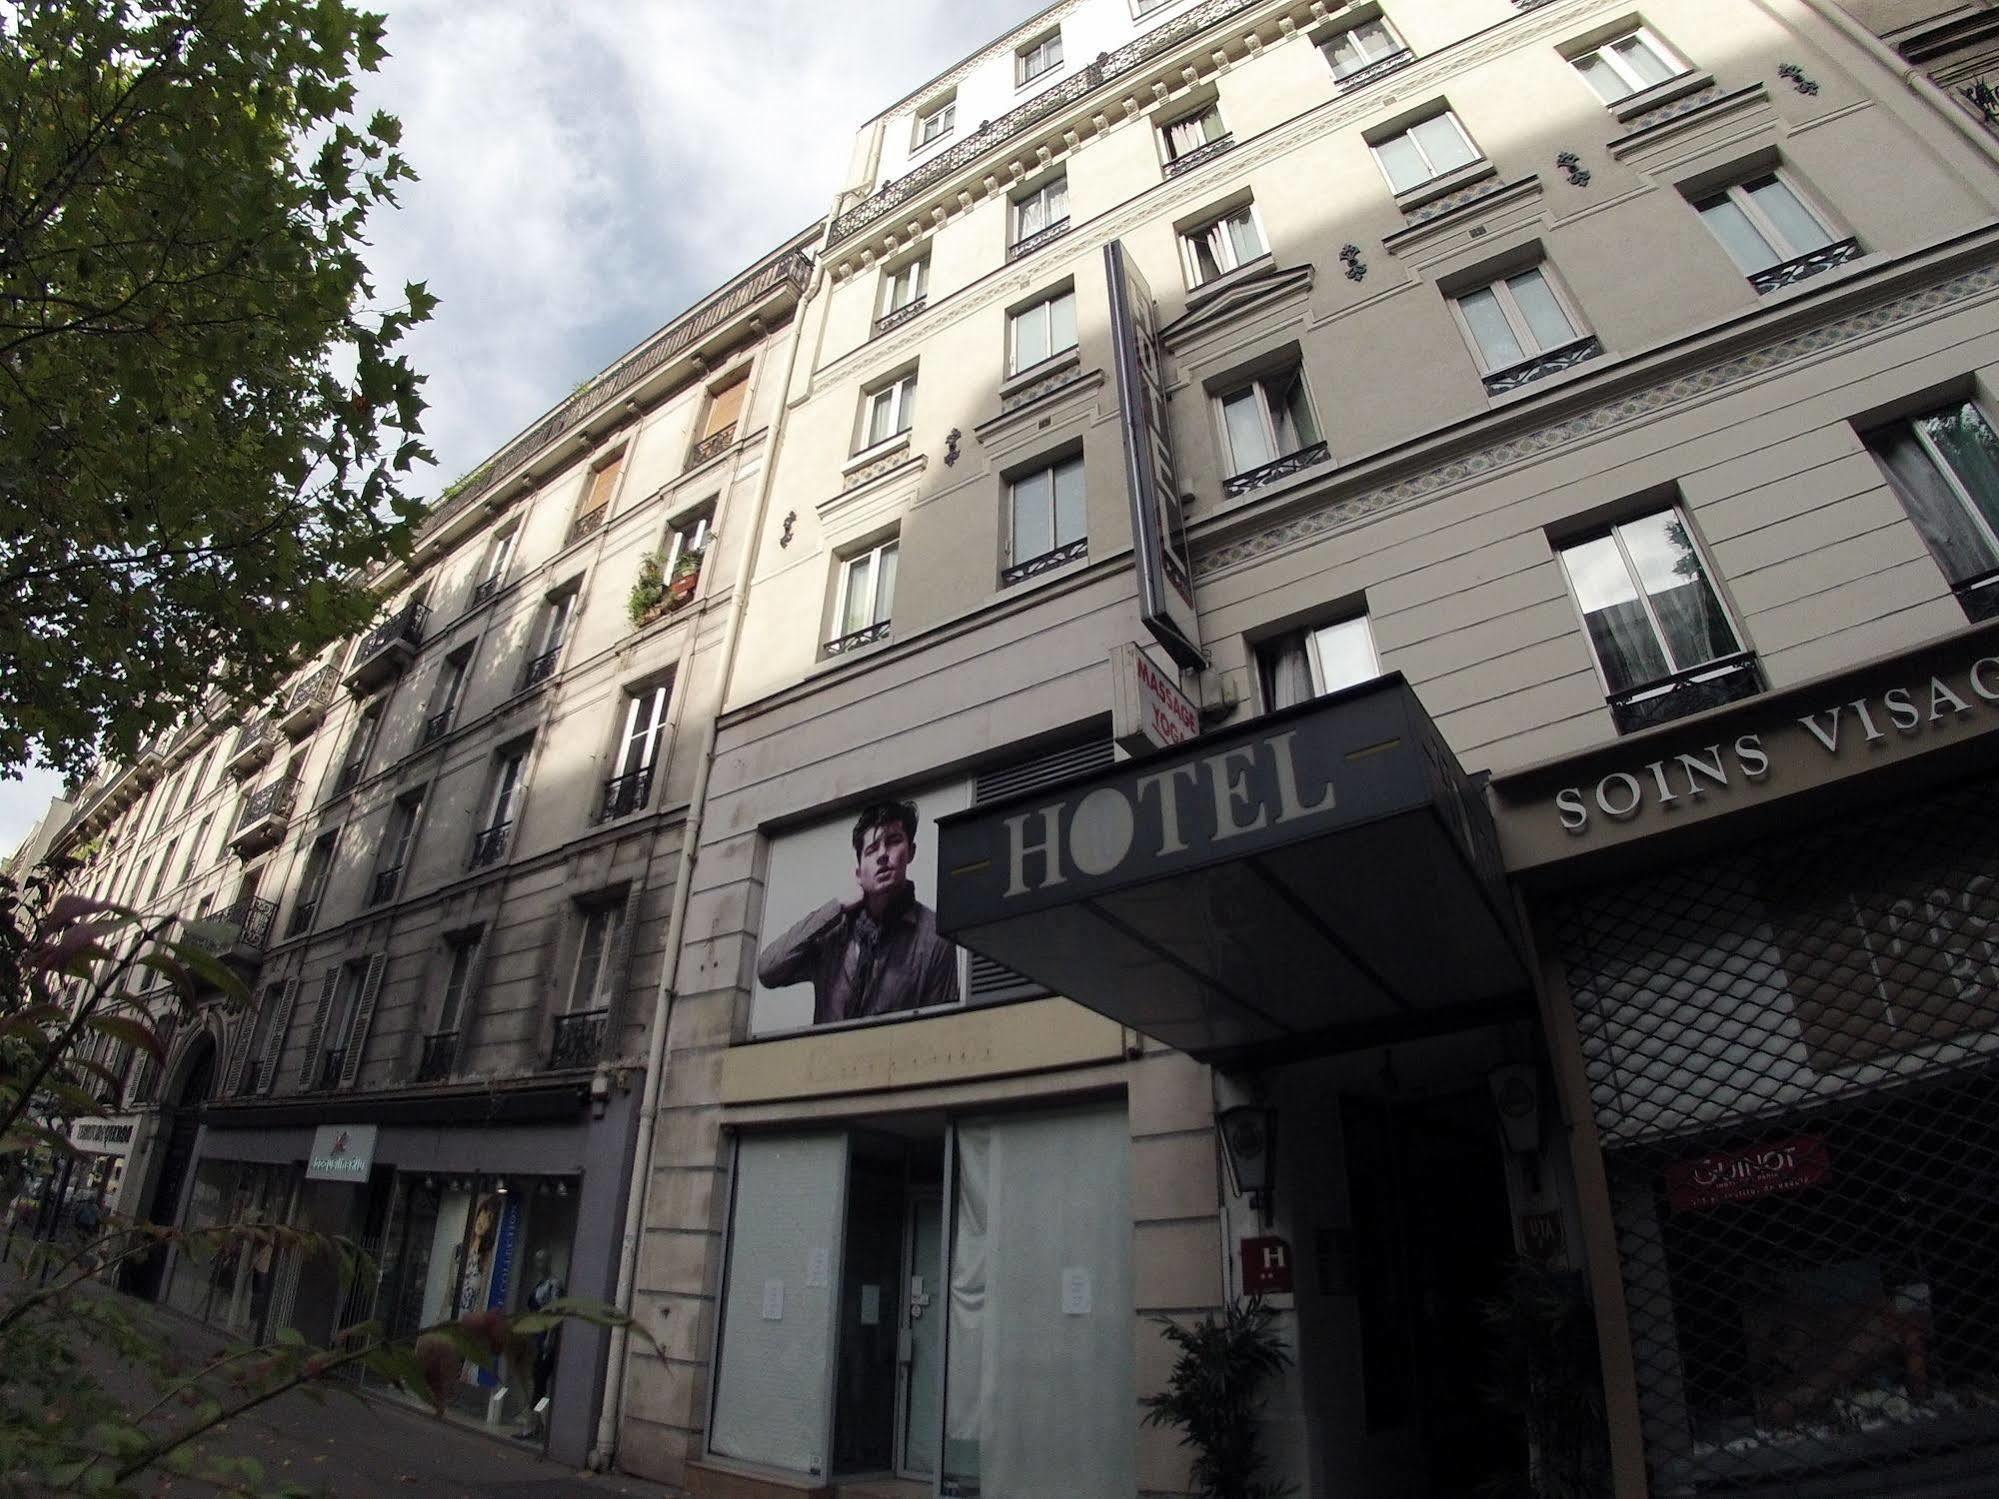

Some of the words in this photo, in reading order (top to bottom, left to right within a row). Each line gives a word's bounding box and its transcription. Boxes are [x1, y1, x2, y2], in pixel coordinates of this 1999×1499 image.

[1128, 276, 1187, 577] HOTEL
[1137, 658, 1196, 734] MASSAGE
[1152, 703, 1185, 744] YOGA
[1003, 731, 1336, 898] HOTEL
[1556, 733, 1769, 830] SOINS
[1694, 1146, 1796, 1184] GUINOT
[1263, 1246, 1285, 1268] H
